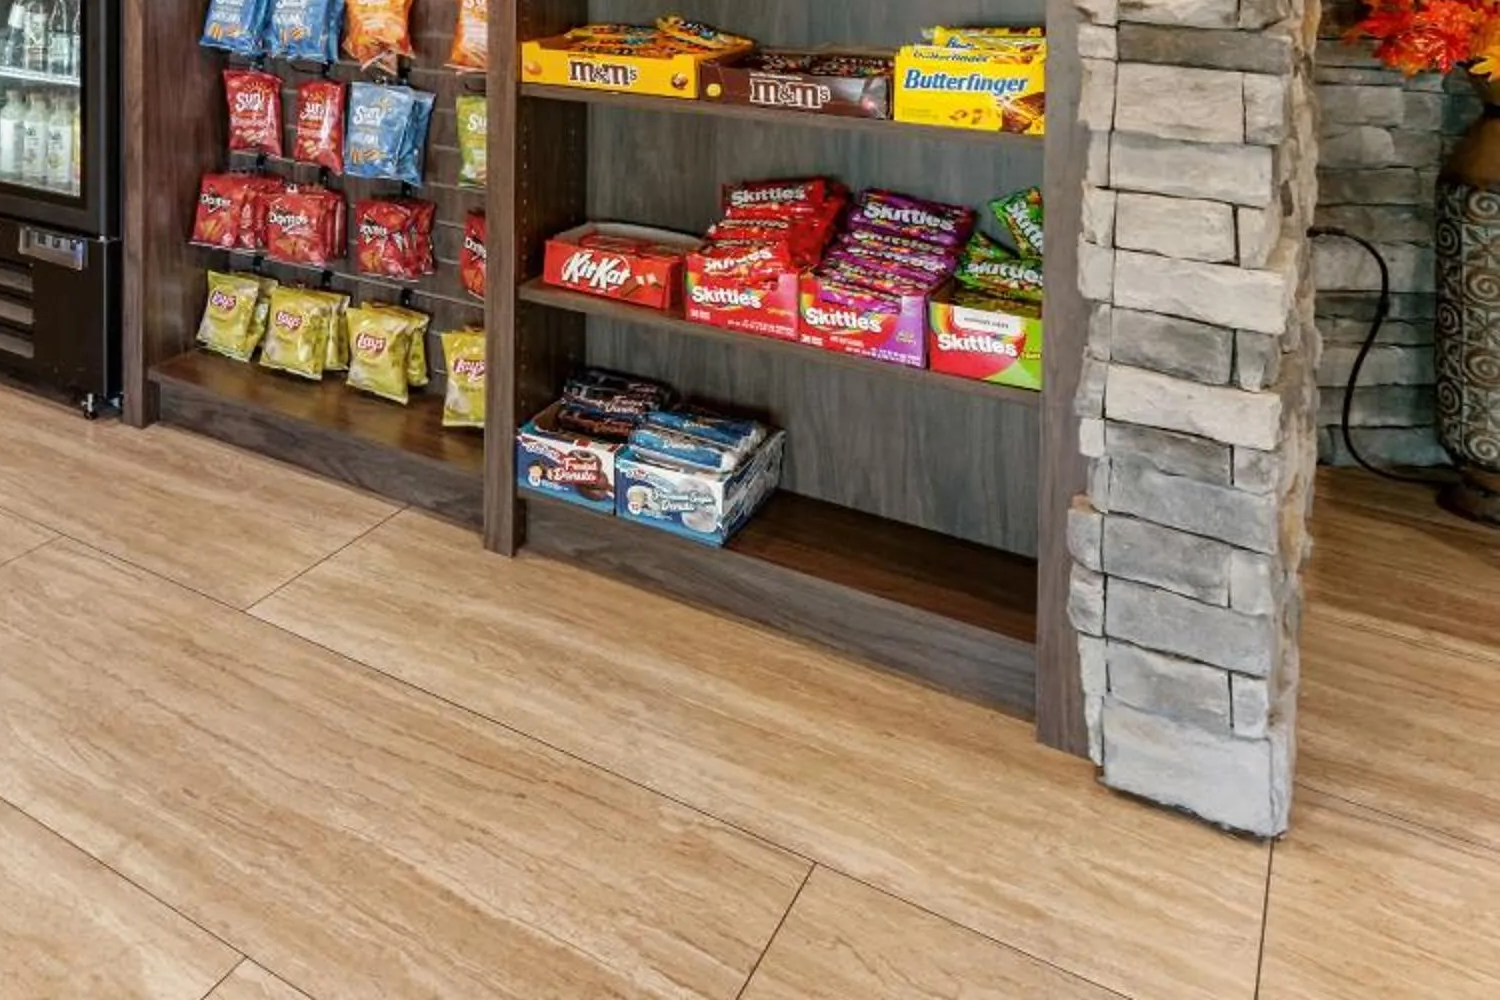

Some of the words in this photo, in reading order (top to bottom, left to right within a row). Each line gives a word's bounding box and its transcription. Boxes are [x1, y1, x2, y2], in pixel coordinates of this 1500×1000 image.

[904, 68, 1029, 96] Butterfinger
[731, 185, 806, 206] Skittles
[863, 201, 956, 232] Skittles
[691, 285, 762, 309] Skittles
[804, 307, 882, 333] Skittles
[937, 332, 1018, 359] Skittles
